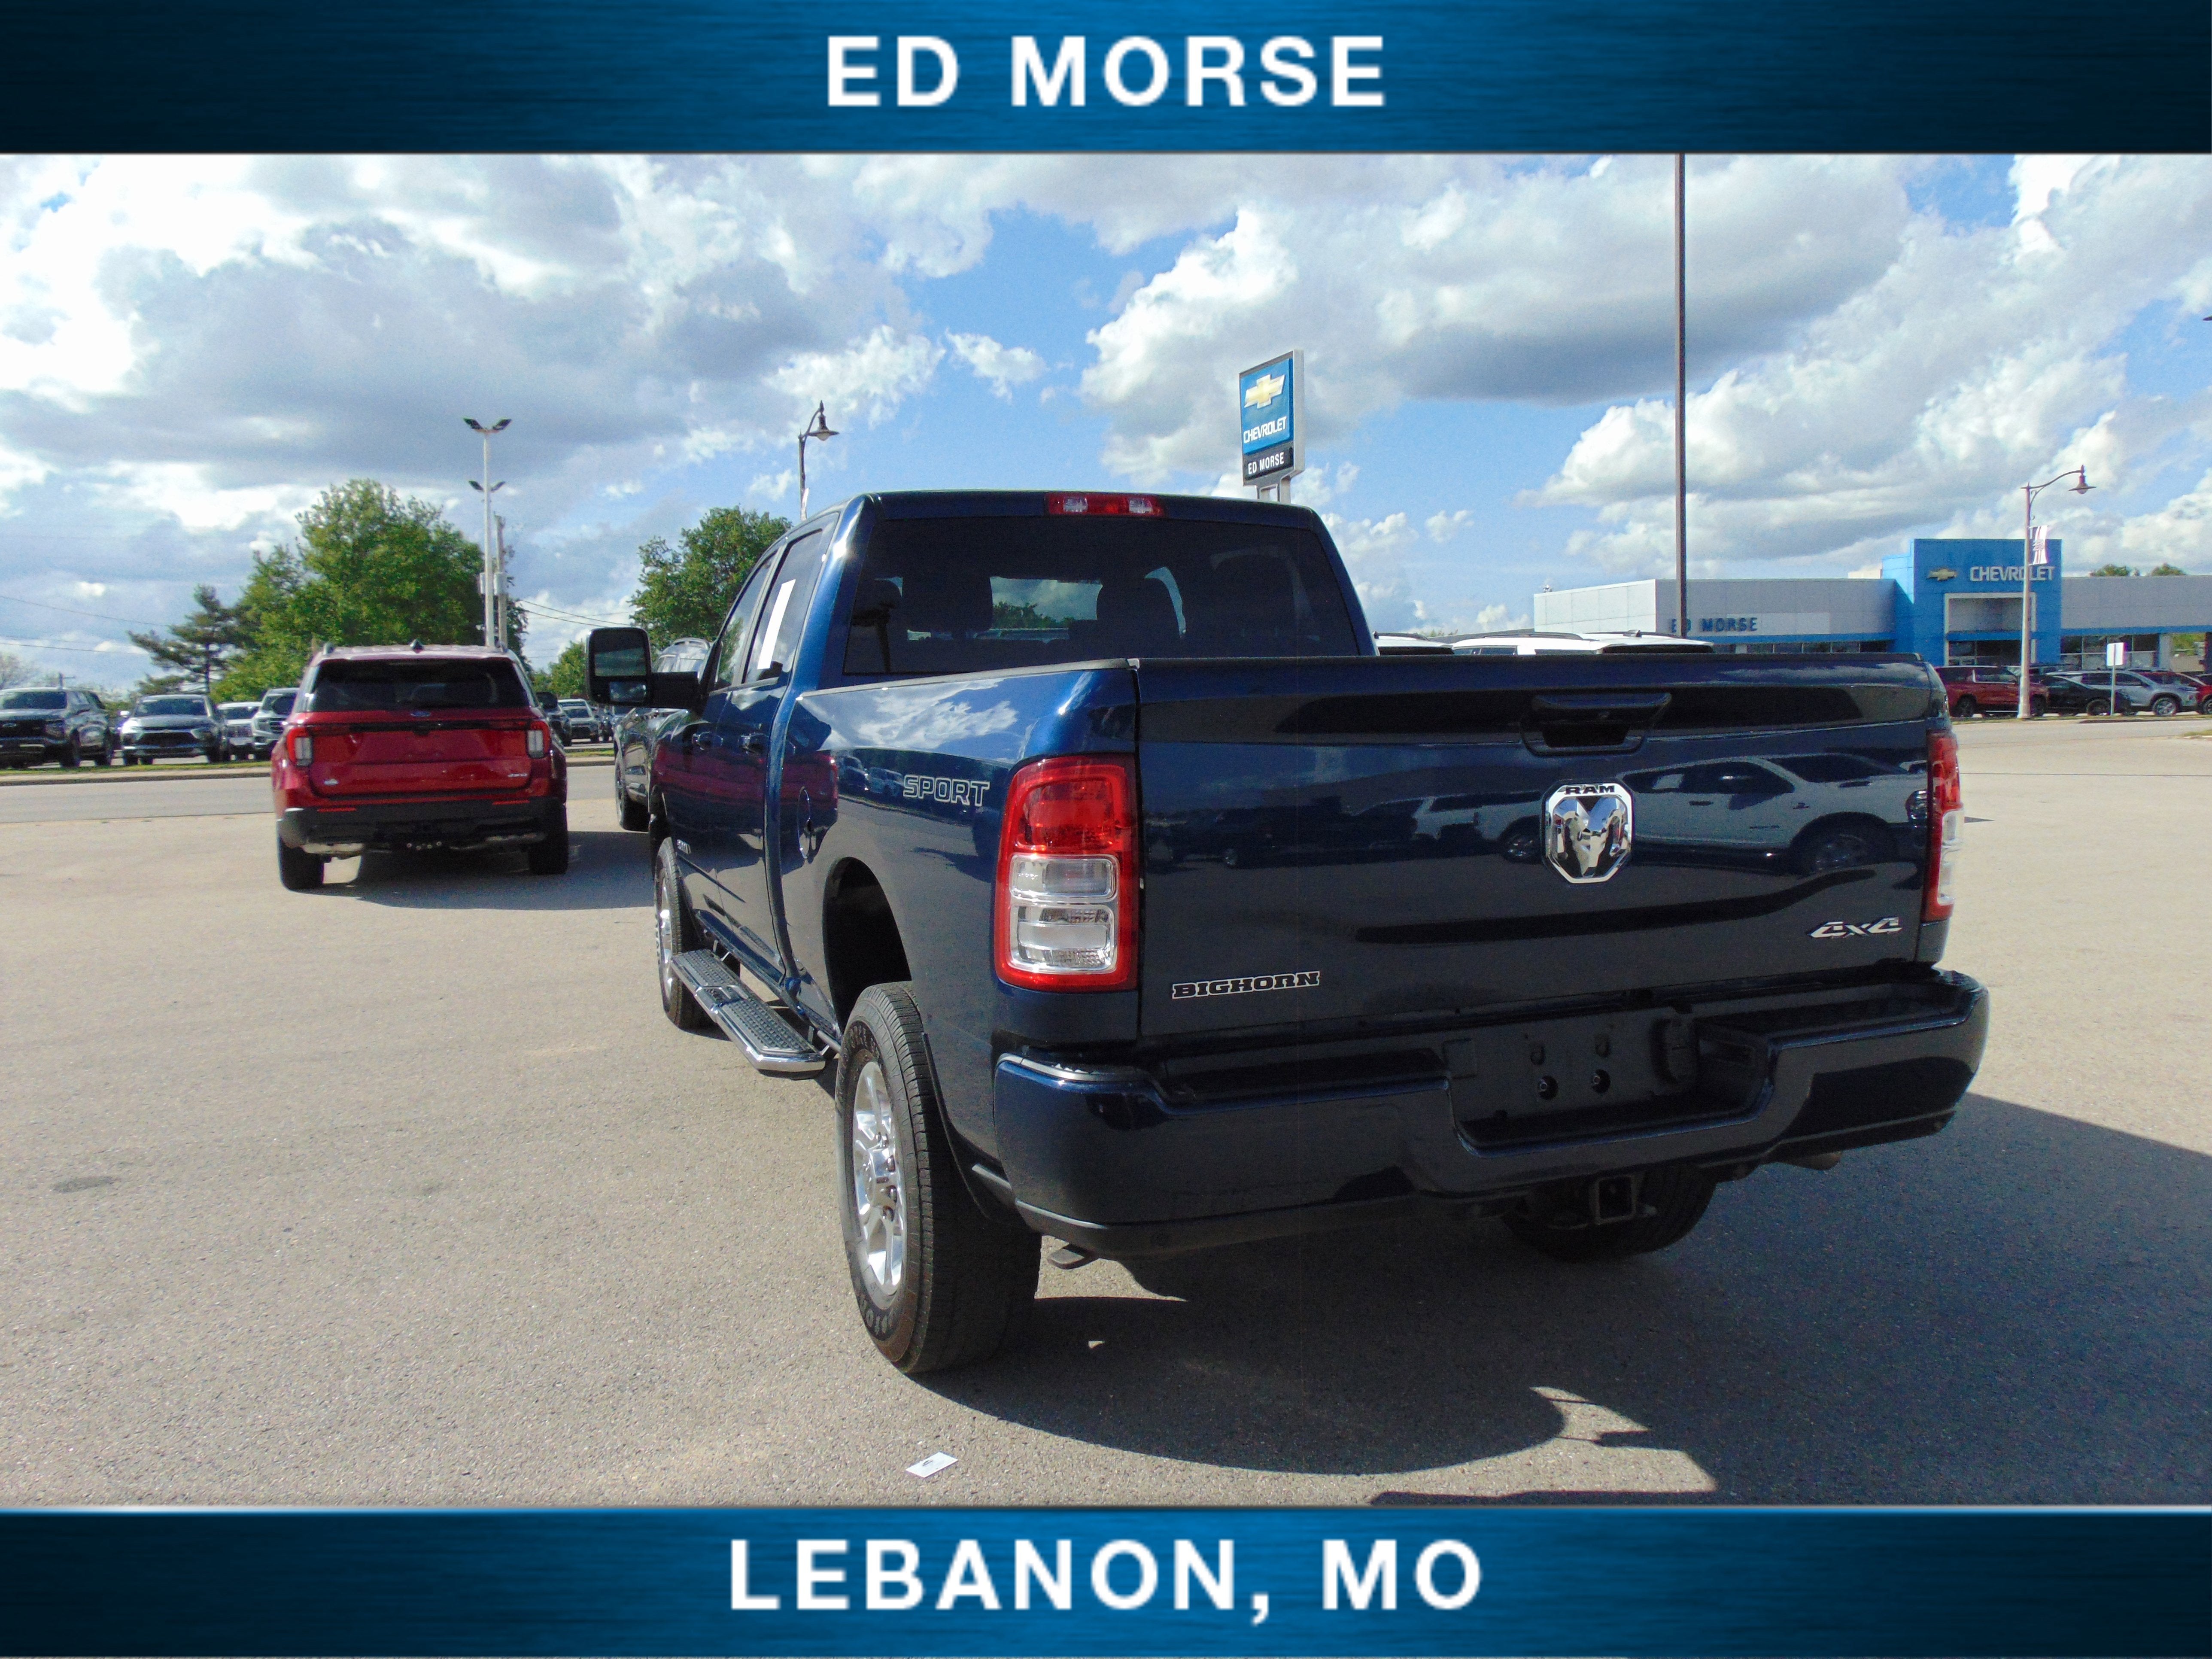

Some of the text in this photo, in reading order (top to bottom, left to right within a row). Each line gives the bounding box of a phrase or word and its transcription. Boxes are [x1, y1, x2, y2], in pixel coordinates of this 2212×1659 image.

[1243, 416, 1287, 444] CHEVROLET
[1248, 452, 1285, 475] ED MORSE
[1702, 617, 1758, 632] MORSE
[902, 774, 991, 807] SPORT
[1564, 785, 1616, 795] RAM
[1172, 970, 1320, 1000] BIGHORN
